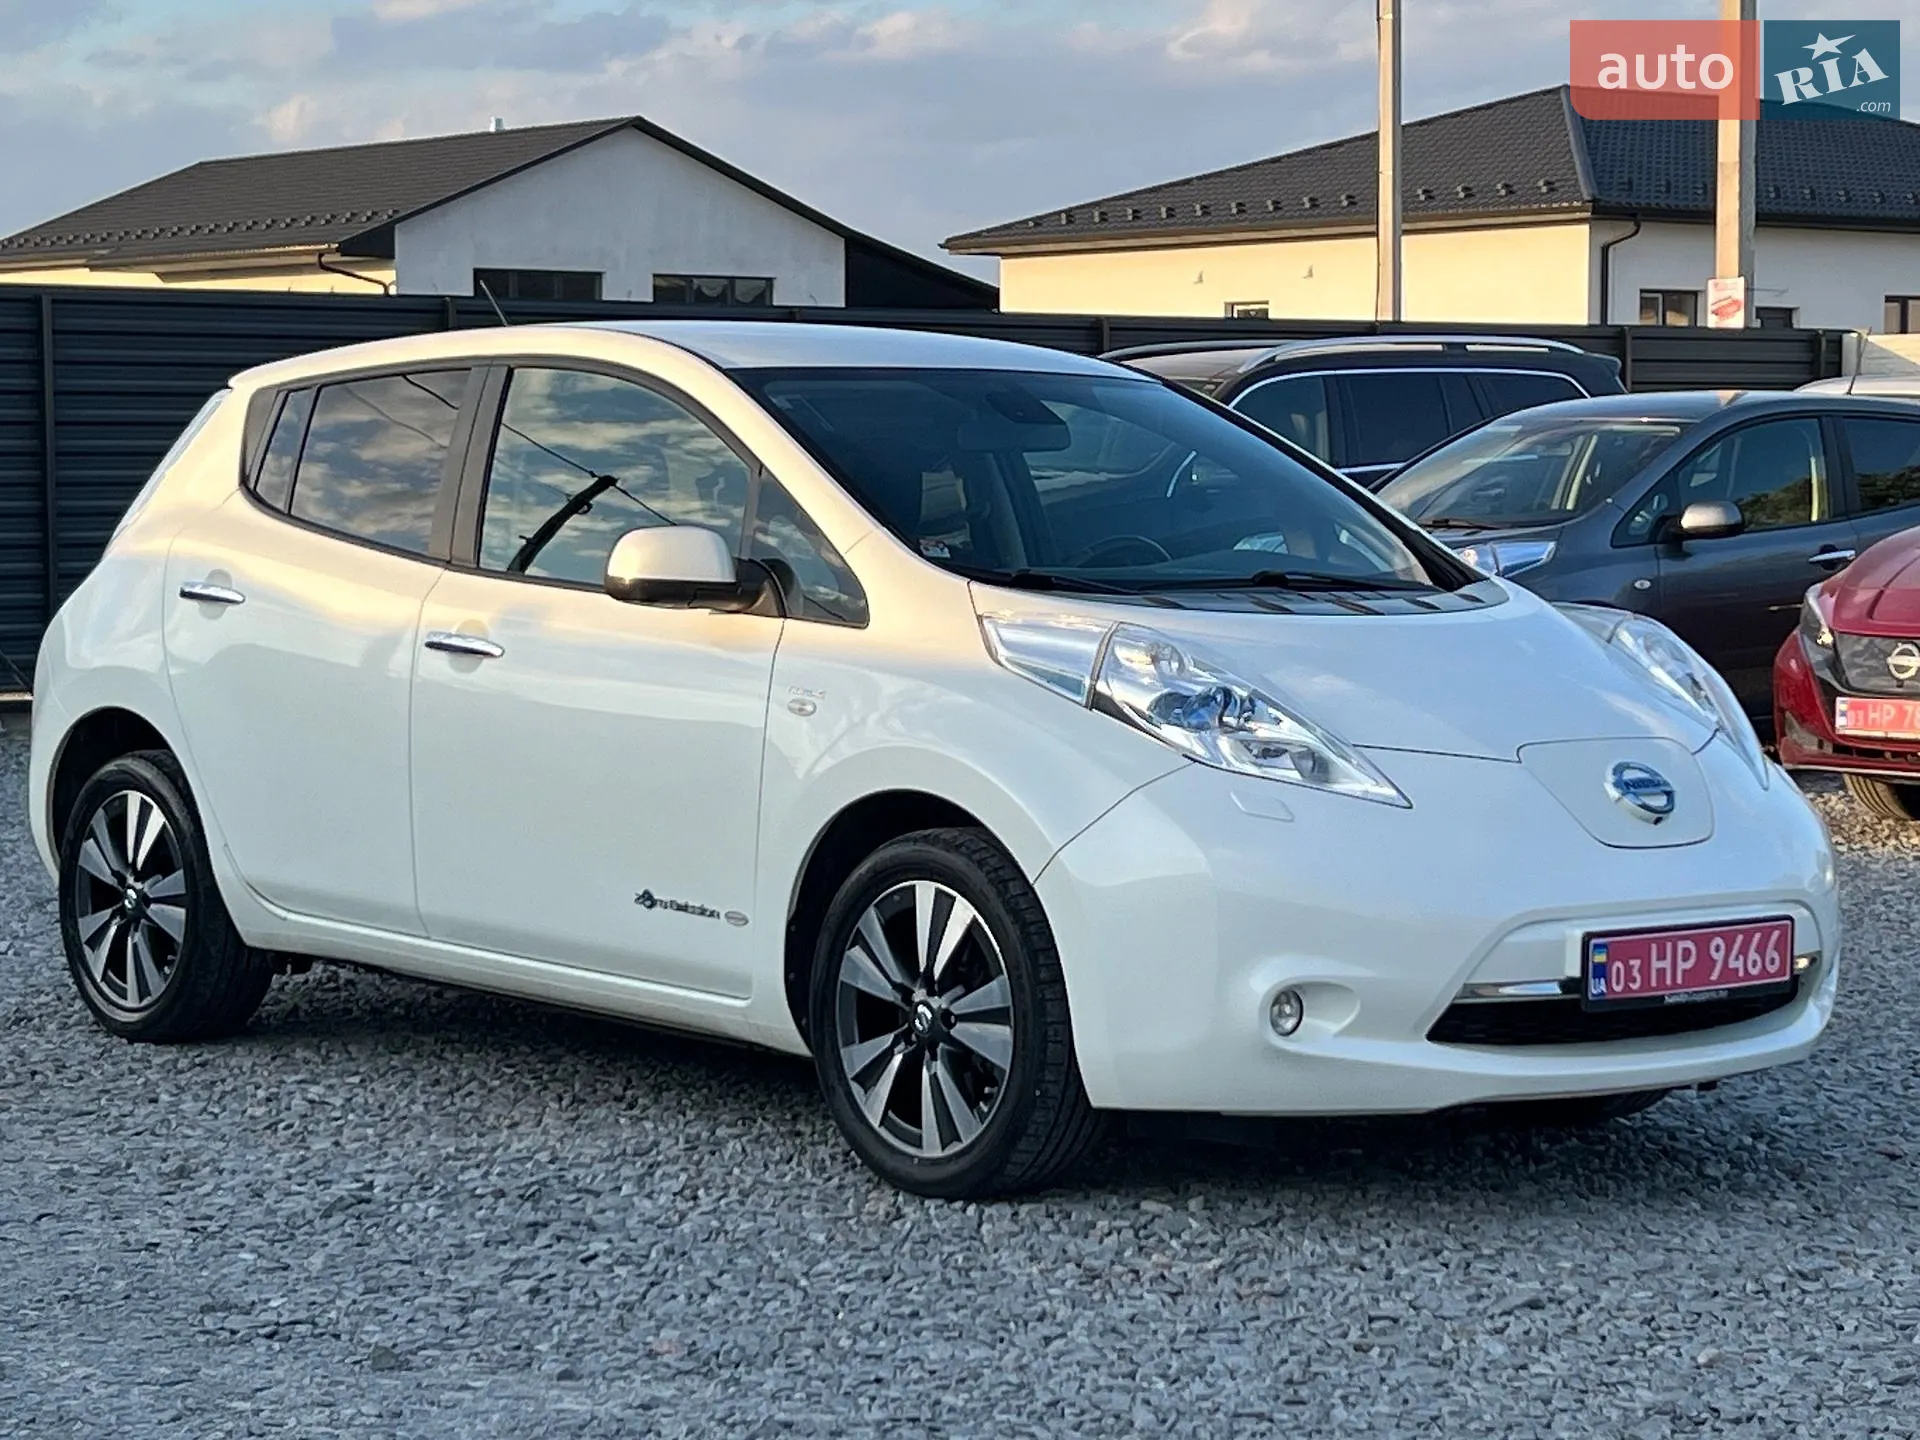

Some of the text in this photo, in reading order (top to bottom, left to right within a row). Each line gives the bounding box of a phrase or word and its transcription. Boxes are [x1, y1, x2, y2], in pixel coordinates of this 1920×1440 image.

[1868, 703, 1896, 728] HP
[1611, 929, 1782, 993] 03 HP 9466
